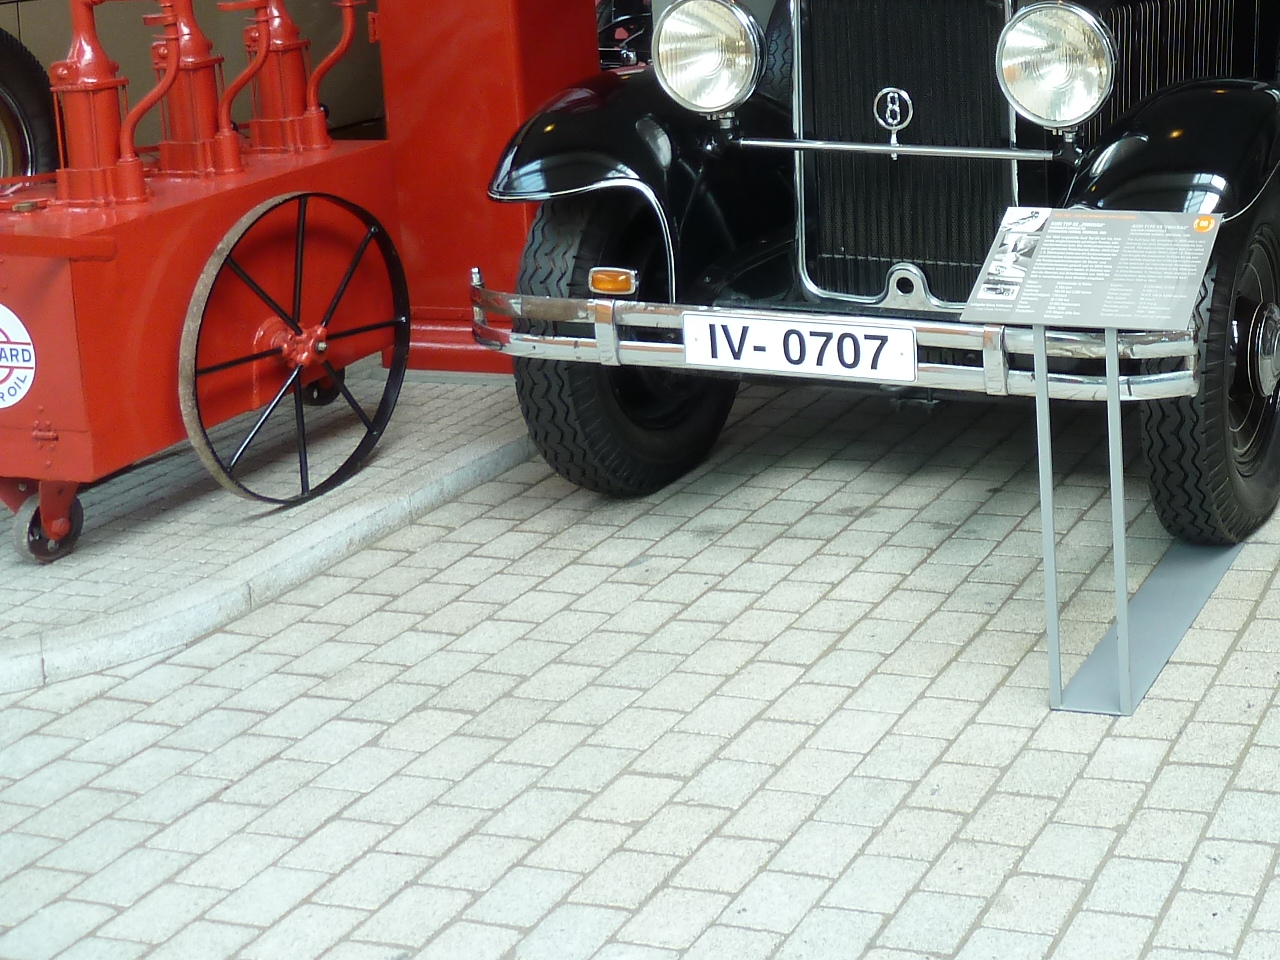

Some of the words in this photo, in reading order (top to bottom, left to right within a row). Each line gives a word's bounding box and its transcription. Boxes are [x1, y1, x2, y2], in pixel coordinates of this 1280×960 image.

[886, 92, 901, 125] 8
[708, 323, 767, 361] IV-
[782, 328, 889, 370] 0707
[7, 374, 28, 397] OIL
